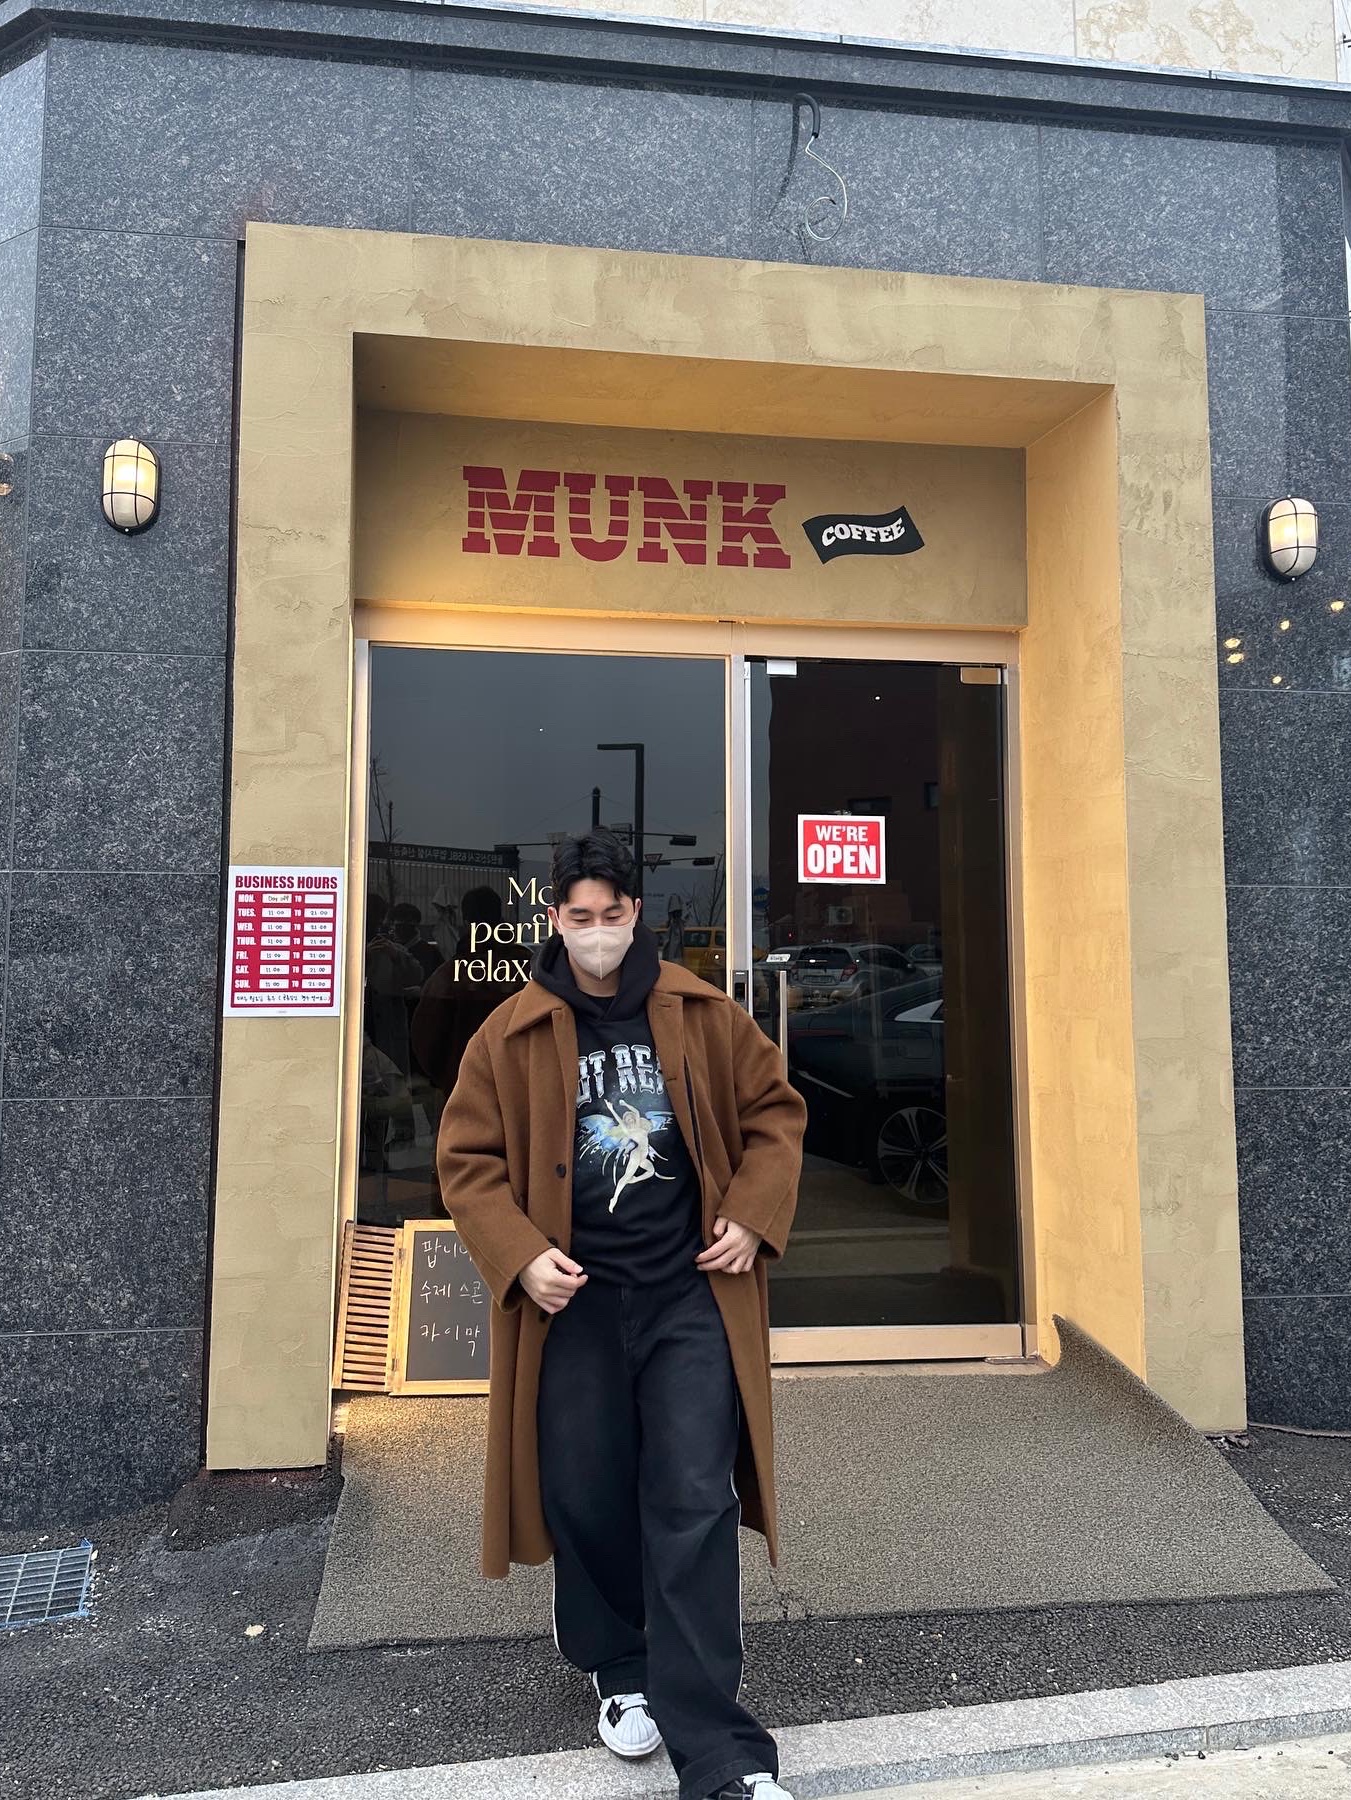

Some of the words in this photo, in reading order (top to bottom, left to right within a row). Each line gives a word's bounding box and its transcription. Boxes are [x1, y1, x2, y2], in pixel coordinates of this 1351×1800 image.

[461, 465, 791, 569] MUNK
[821, 517, 906, 547] COFFEE
[815, 825, 868, 842] WE'RE
[806, 843, 876, 875] OPEN
[235, 876, 295, 888] BUSINESS
[297, 876, 338, 889] HOURS
[454, 950, 532, 982] relax
[420, 1280, 450, 1304] 수제
[460, 1280, 484, 1304] 스콘
[420, 1322, 480, 1356] 카이막
